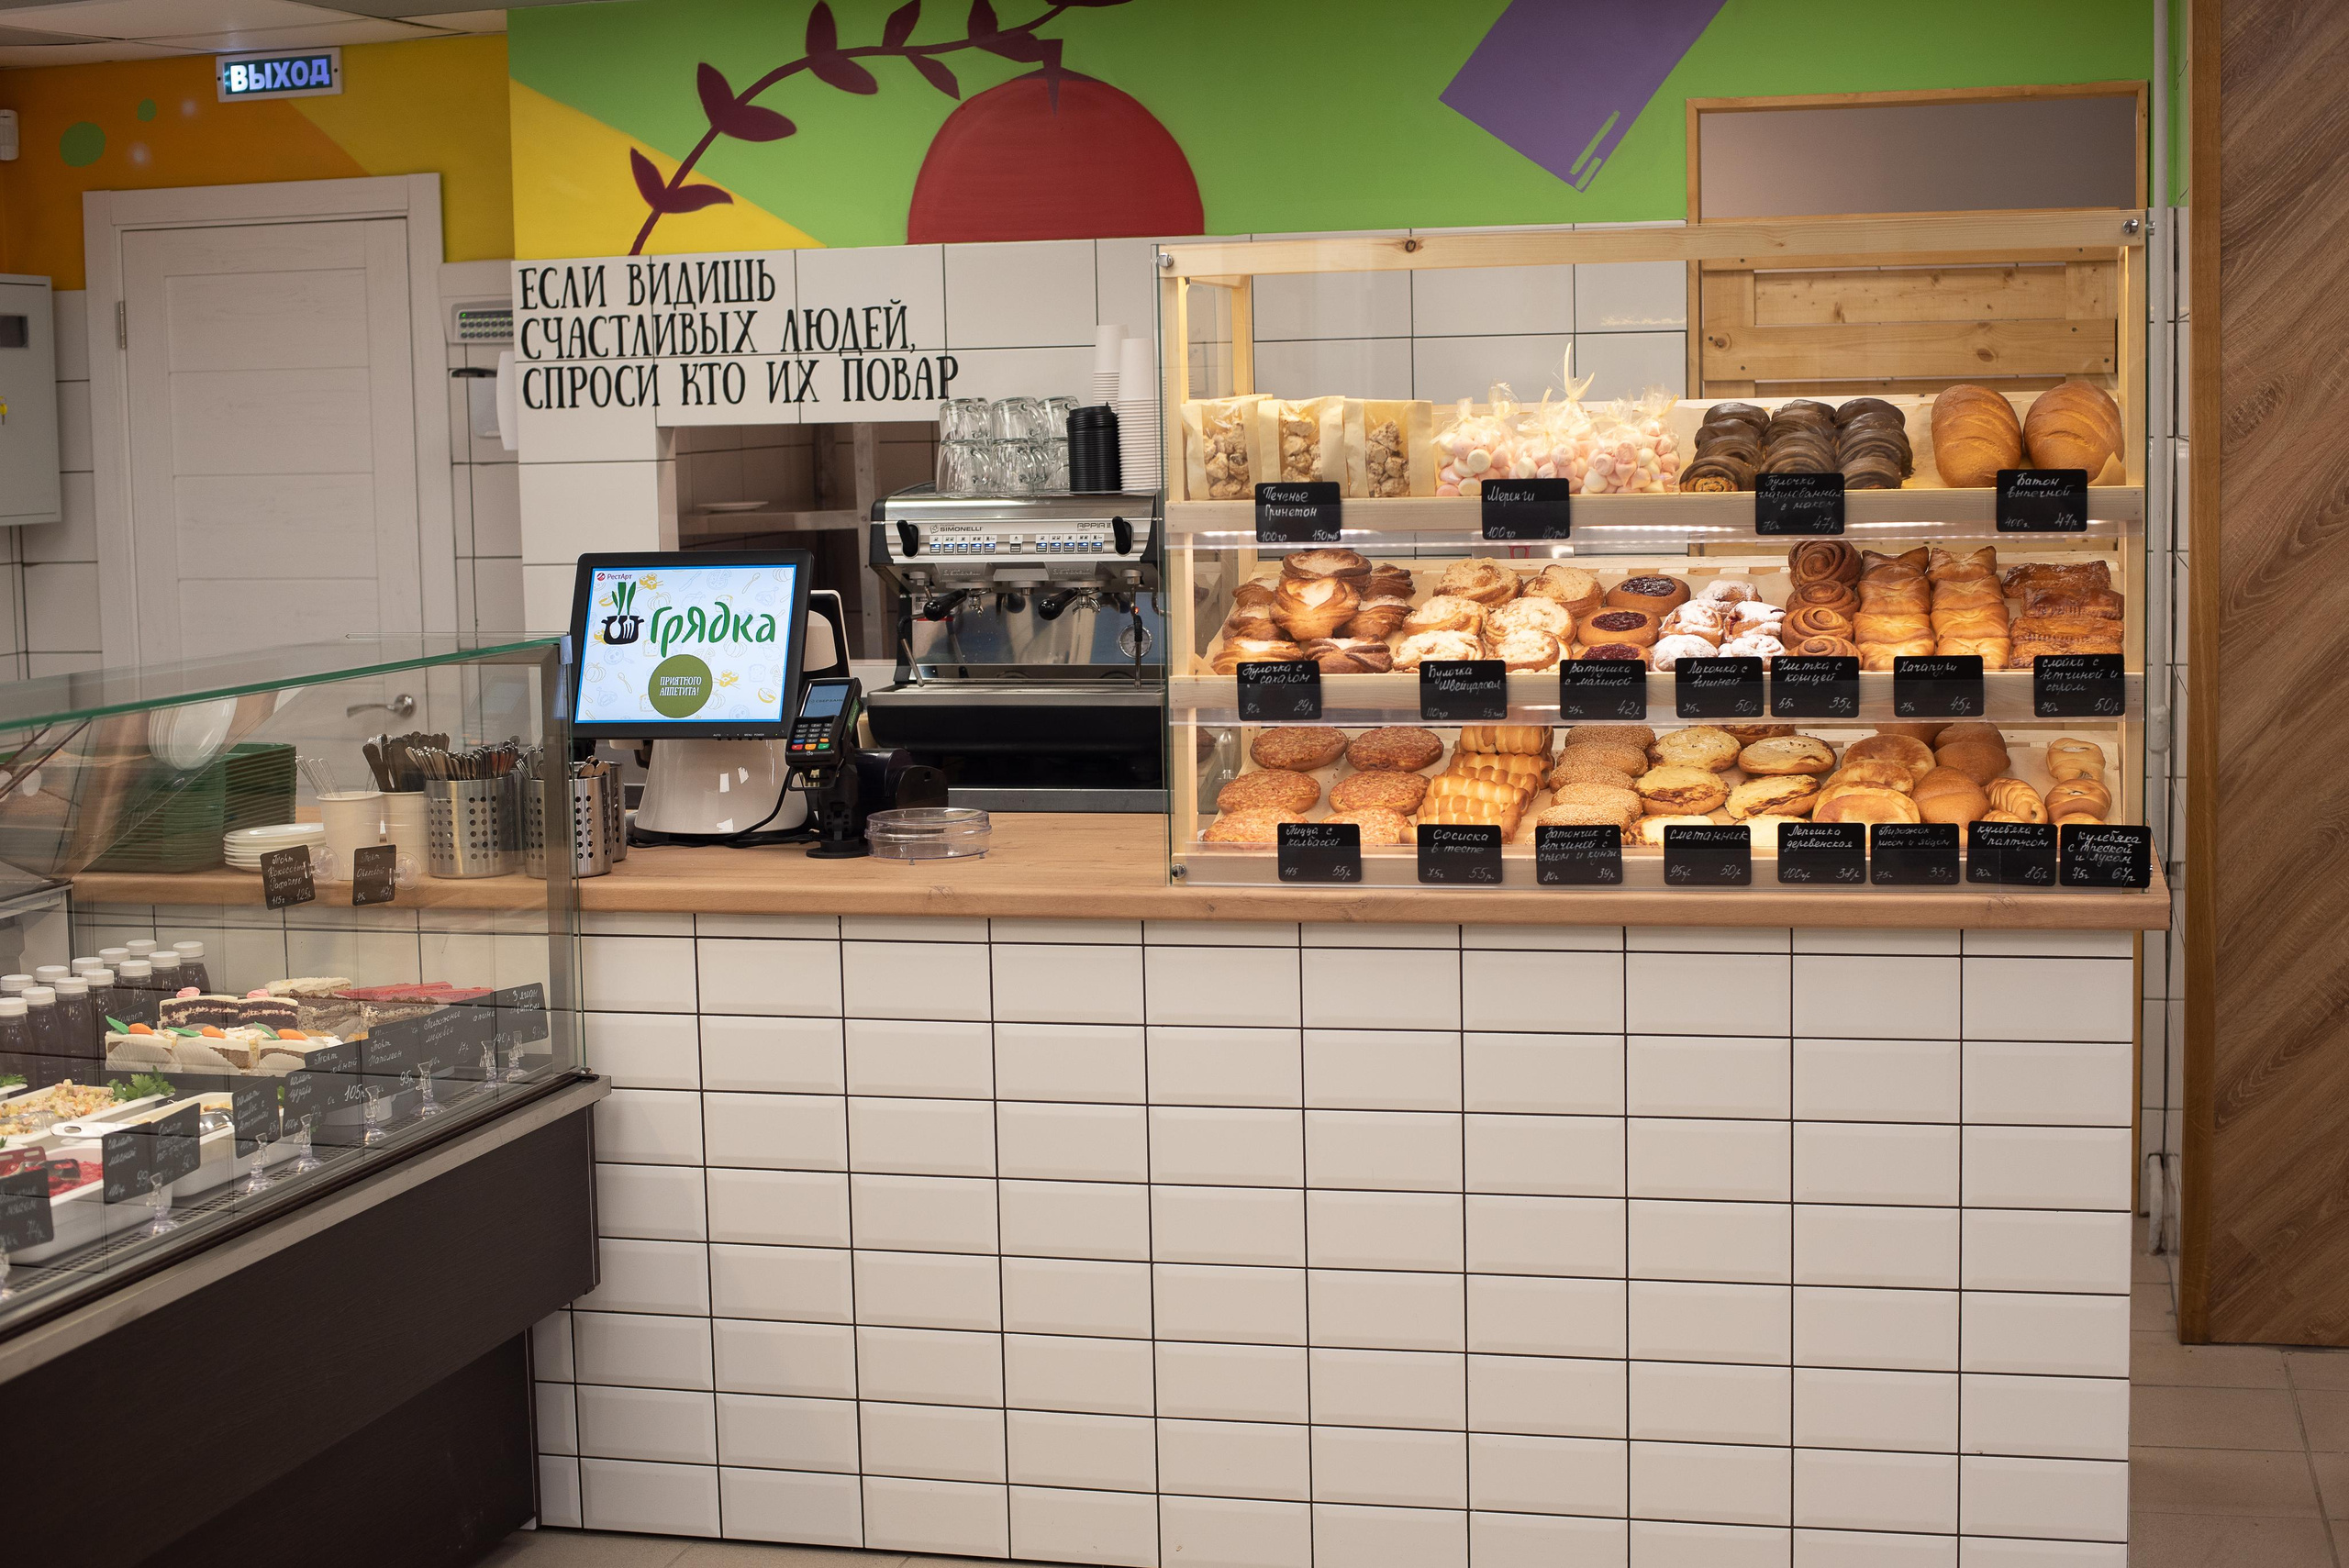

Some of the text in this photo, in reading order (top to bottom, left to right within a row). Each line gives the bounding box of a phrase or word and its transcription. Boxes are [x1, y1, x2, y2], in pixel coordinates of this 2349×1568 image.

[229, 58, 330, 93] ВЫХОД
[518, 259, 775, 311] ЕСЛИ ВИДИШЬ
[520, 298, 916, 360] СЧАСТЛИВЫХ ЛЮДЕЙ,
[522, 355, 959, 410] СПРОСИ КТО ИХ ПОВАР
[1765, 475, 1816, 491] Булочка
[2017, 473, 2060, 486] Батон
[1263, 486, 1309, 503] Печенье
[1792, 501, 1835, 510] маком
[607, 573, 633, 581] РестАрт
[1687, 660, 1749, 674] Лакомка с
[1777, 658, 1842, 671] Улитка с
[2092, 658, 2099, 666] с
[1242, 663, 1303, 680] Булочка с
[1428, 663, 1473, 684] Булочка
[1568, 662, 1631, 678] Ватрушка
[1898, 661, 1958, 677] Хачапури
[2110, 670, 2119, 679] и
[660, 676, 702, 686] ПРИЯТНОГО
[1260, 673, 1310, 689] сахаром
[1575, 677, 1633, 686] малиной
[1784, 673, 1837, 686] корицей
[659, 686, 699, 696] АППЕТИТА!
[2045, 683, 2088, 695] сыром
[1286, 824, 1333, 837] Пицца с
[1433, 828, 1489, 841] Сосиска
[1545, 827, 1599, 839] Батончик
[1670, 828, 1750, 841] Сметанник
[1787, 825, 1842, 837] Лепешка
[1878, 825, 1931, 839] Пирожок
[2037, 828, 2044, 836] с
[1286, 836, 1341, 847] колбасой
[1431, 842, 1485, 854] в тесте
[1784, 838, 1853, 853] деревенская
[1987, 838, 2049, 851] палтусом
[2067, 843, 2132, 859] с треской
[1539, 853, 1570, 863] сыром
[2089, 854, 2132, 867] луком
